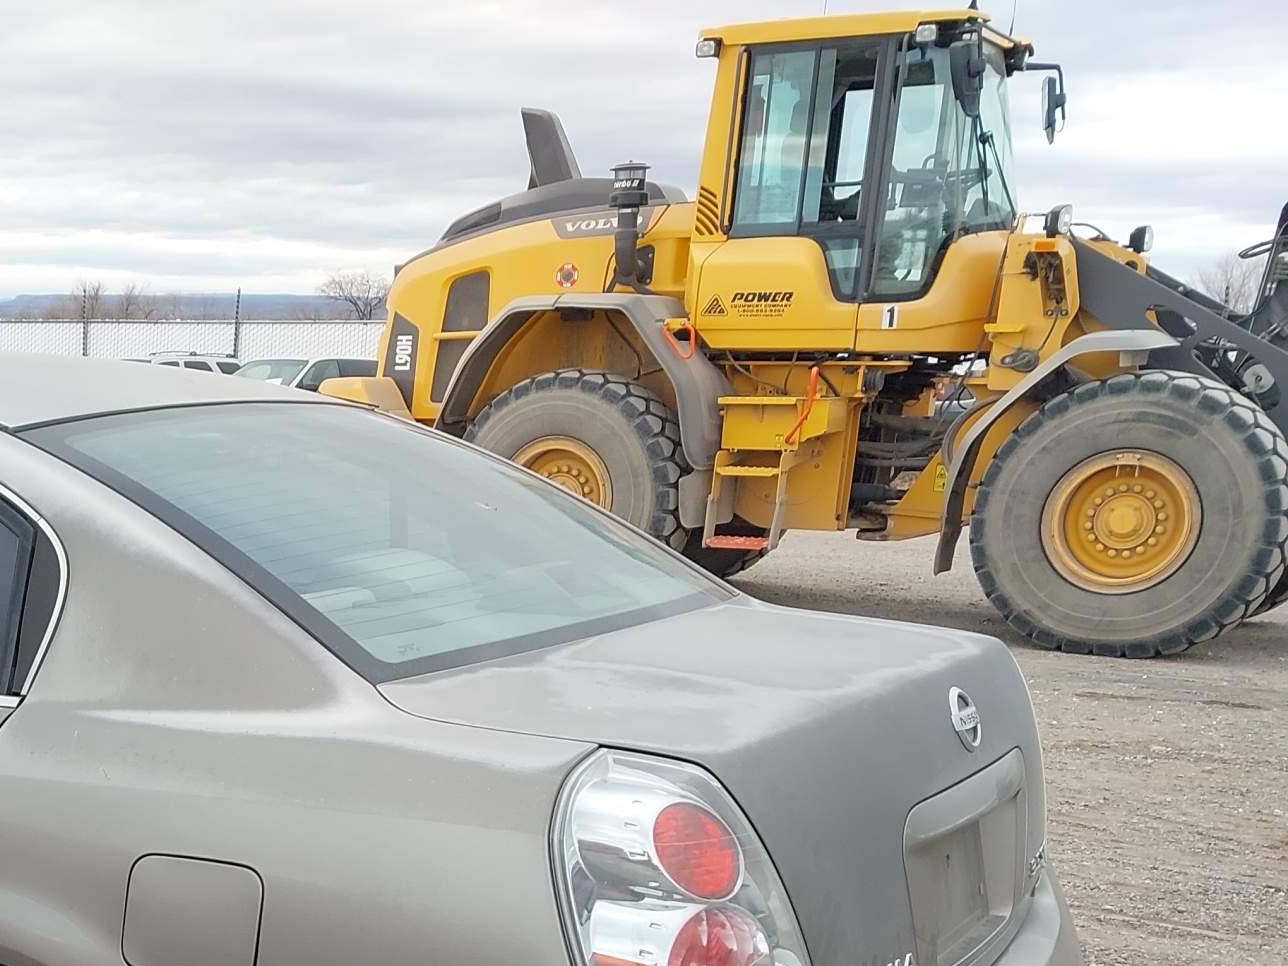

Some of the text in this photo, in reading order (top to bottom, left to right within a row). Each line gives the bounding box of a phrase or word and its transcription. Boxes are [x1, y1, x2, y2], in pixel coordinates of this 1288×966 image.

[731, 291, 794, 303] POWER
[886, 305, 896, 328] 1
[394, 335, 413, 371] L90H
